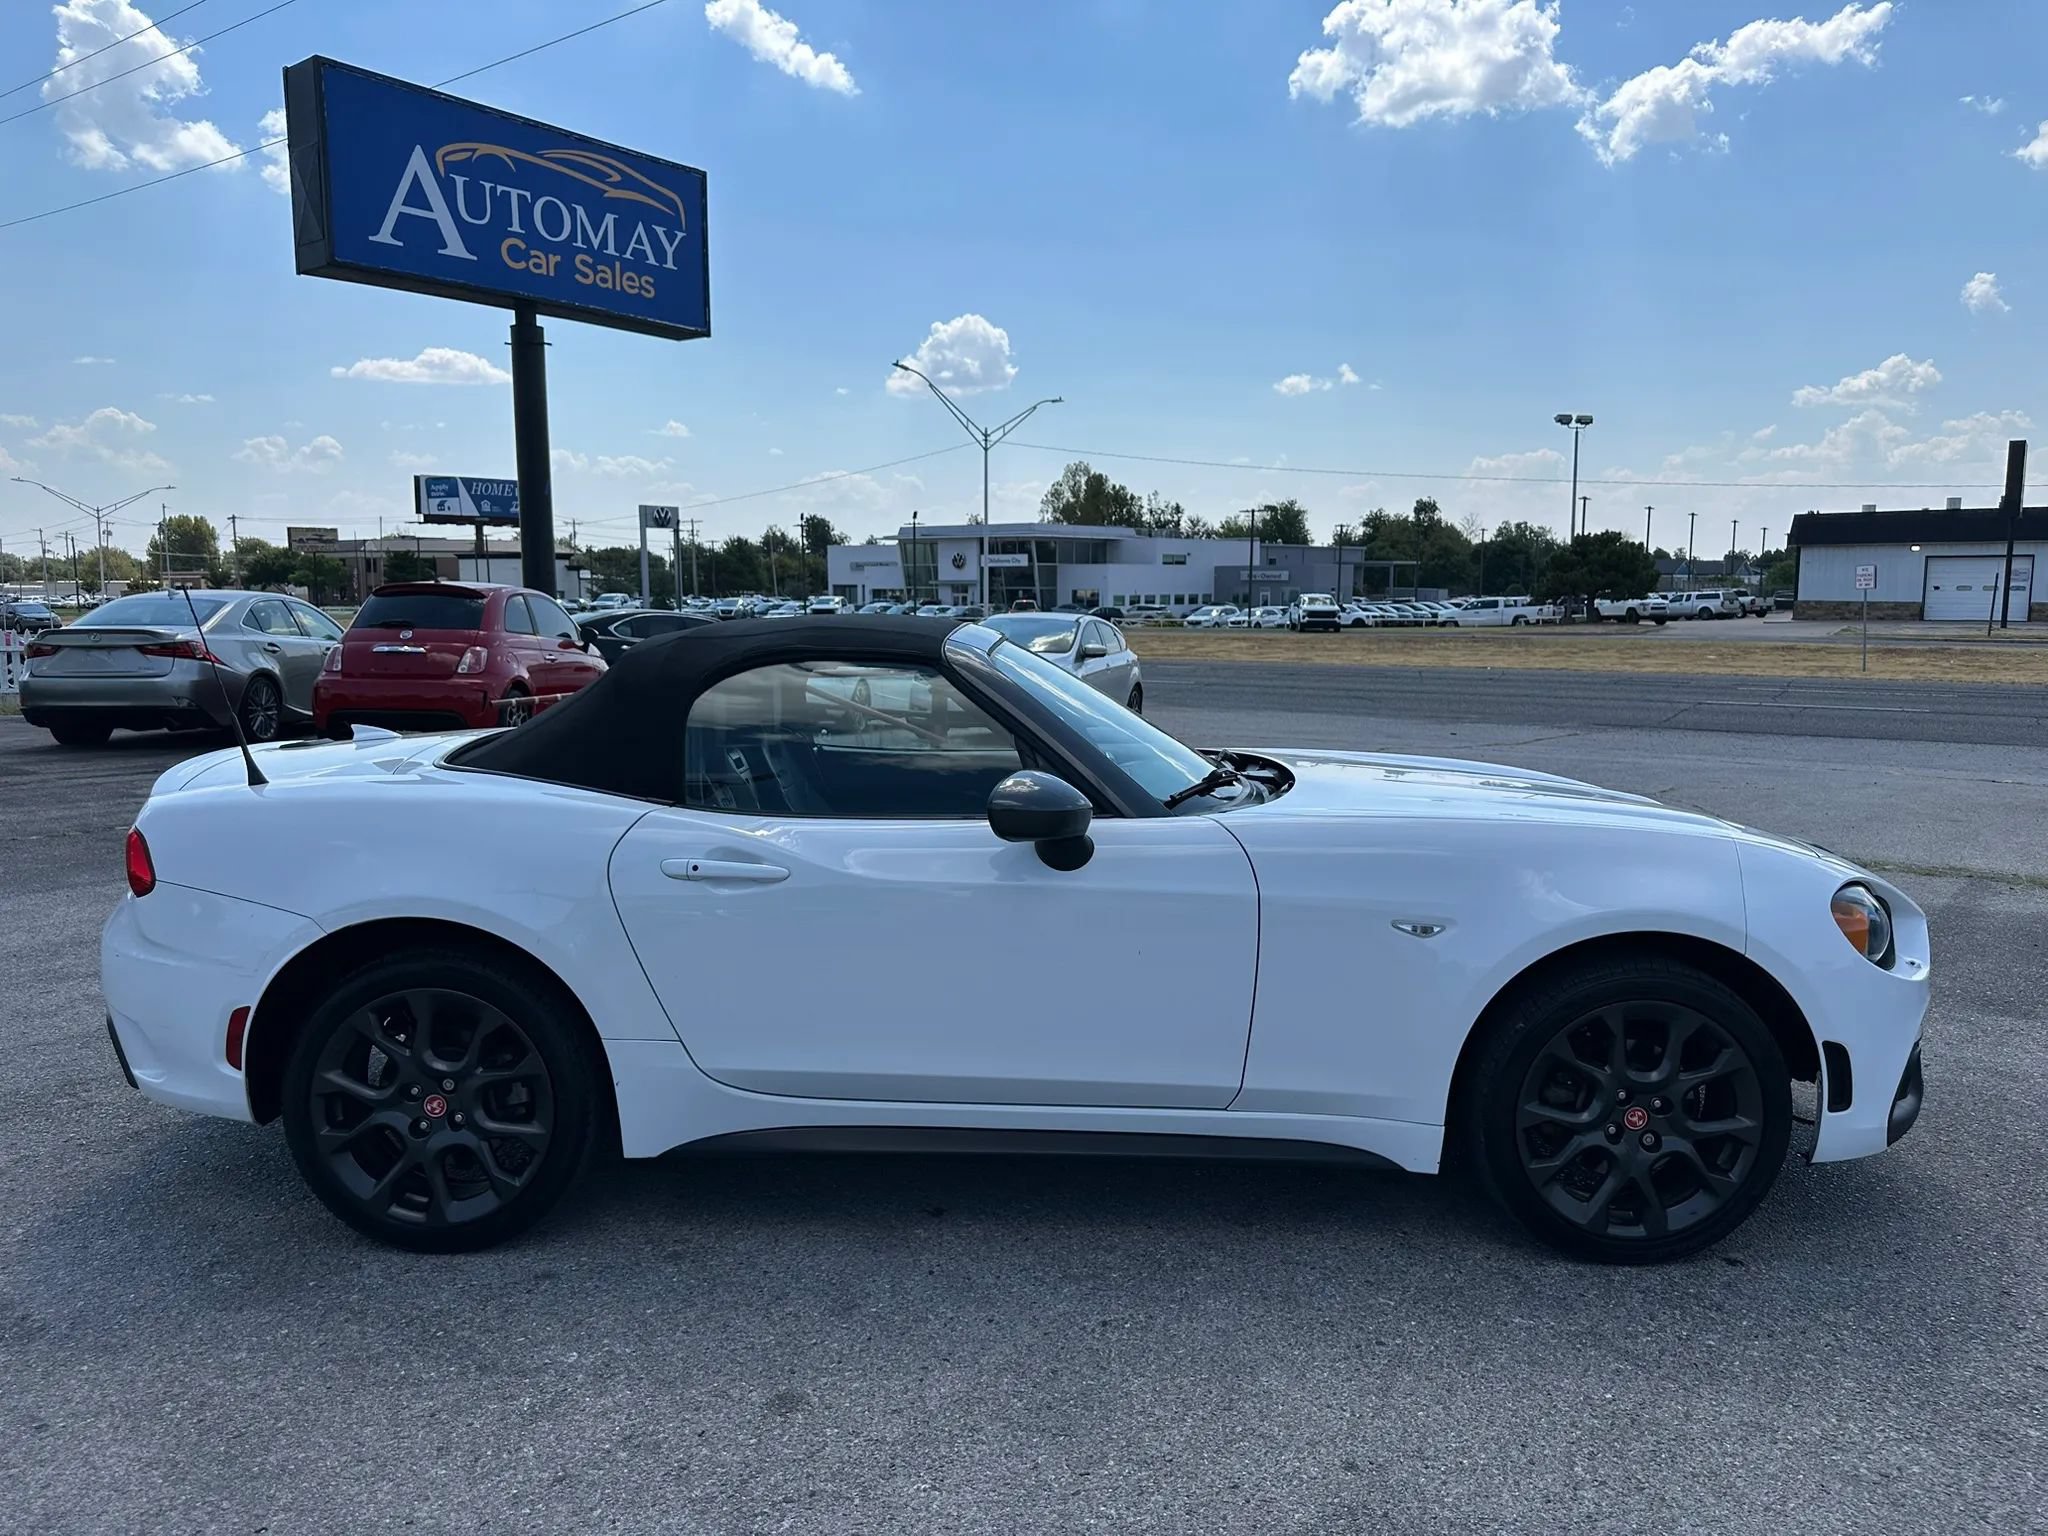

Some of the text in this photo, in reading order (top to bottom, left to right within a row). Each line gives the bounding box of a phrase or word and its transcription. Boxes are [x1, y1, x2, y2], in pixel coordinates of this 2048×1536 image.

[368, 144, 687, 271] AUTOMAY
[500, 238, 656, 299] Car Sales
[471, 482, 514, 497] HOME
